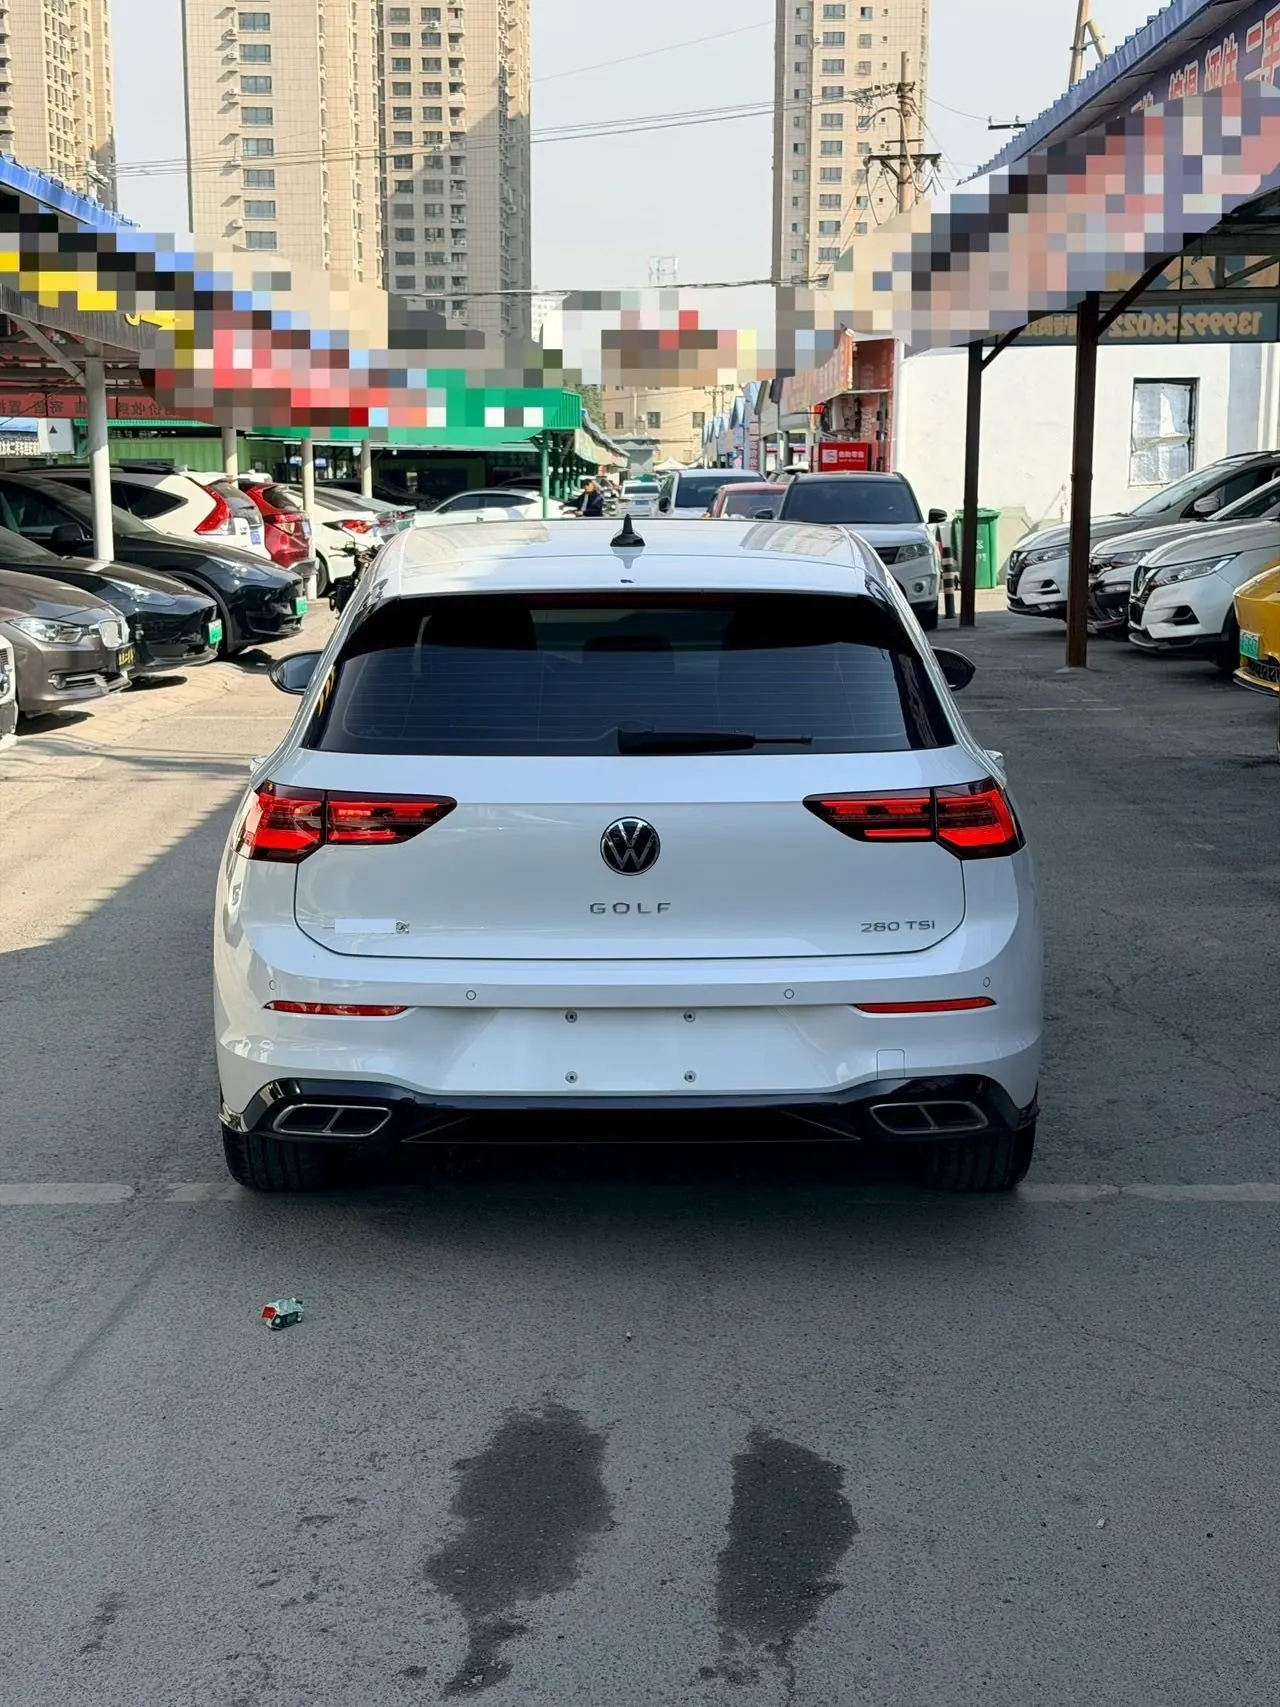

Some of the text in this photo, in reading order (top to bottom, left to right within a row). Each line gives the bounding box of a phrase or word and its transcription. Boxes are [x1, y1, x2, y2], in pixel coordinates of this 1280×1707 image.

[589, 902, 672, 915] GOLF
[860, 920, 936, 933] 280 TSI
